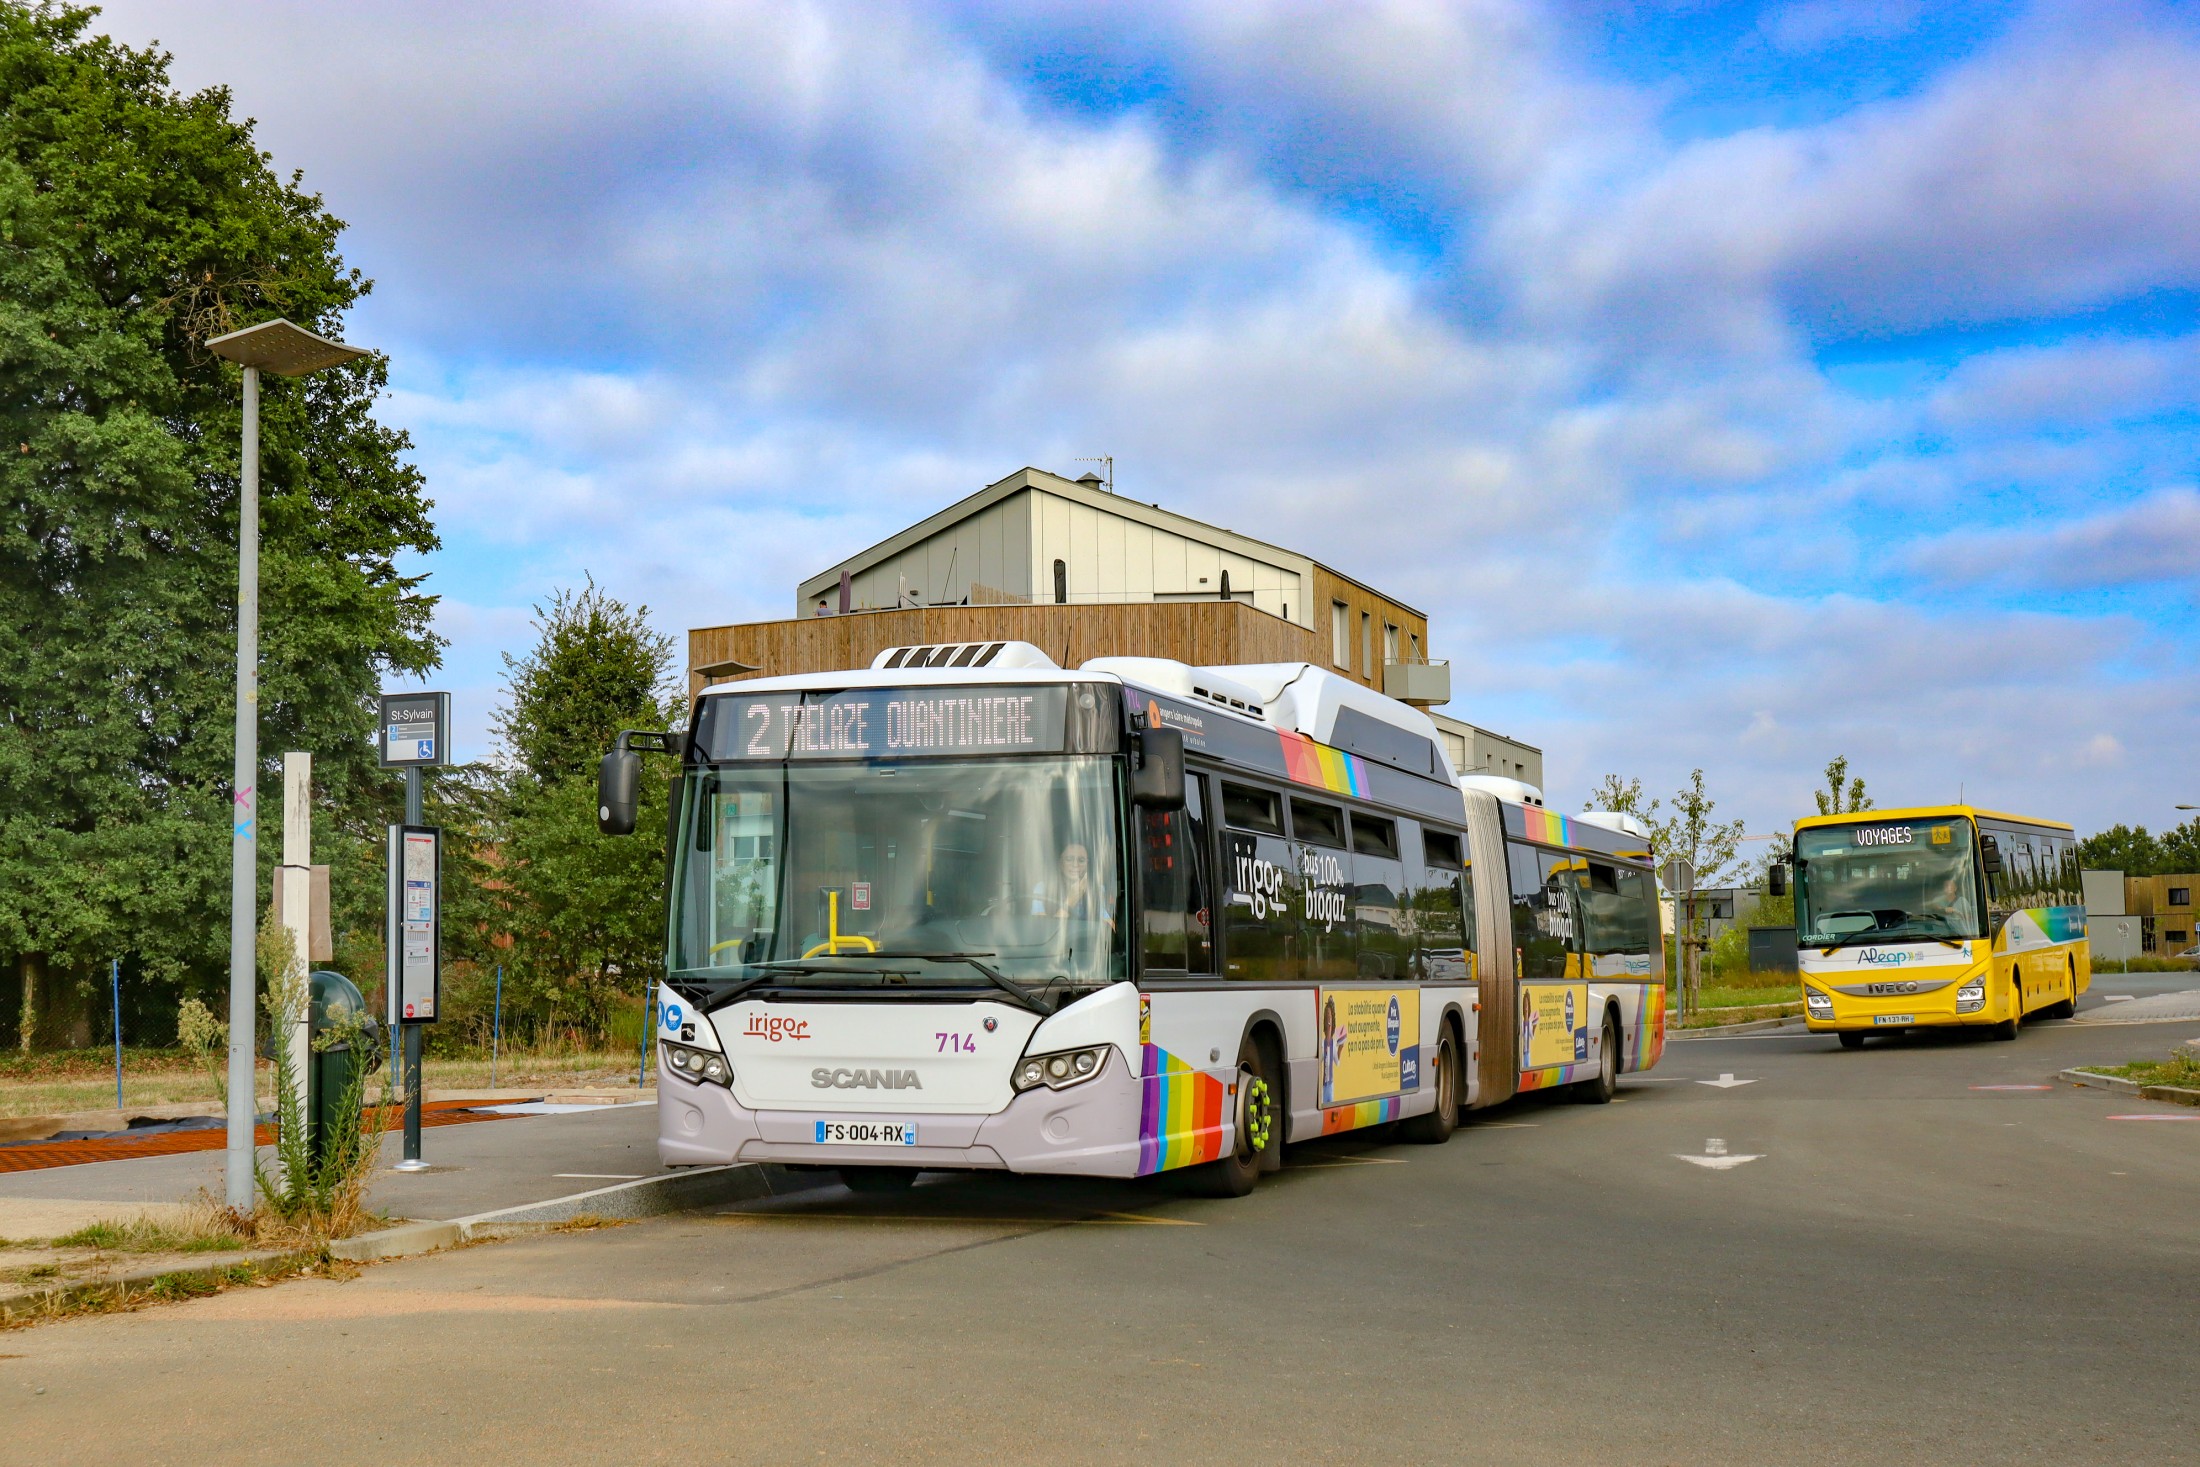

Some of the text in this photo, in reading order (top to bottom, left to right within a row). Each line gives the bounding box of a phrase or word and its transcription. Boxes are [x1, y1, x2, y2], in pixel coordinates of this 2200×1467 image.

[391, 708, 433, 722] St-Sylvain
[747, 696, 1033, 755] 2 TRELAZE QUANTINIERE
[1856, 826, 1912, 847] VOYAGES
[1303, 847, 1344, 888] bus 100%
[1234, 842, 1285, 920] irigo
[1305, 878, 1347, 933] biogaz
[1548, 908, 1573, 946] biogaz
[1802, 932, 1836, 942] CORDIER
[1857, 947, 1907, 967] Aléop
[1868, 981, 1918, 994] IVECO
[745, 1012, 808, 1042] irigo
[935, 1032, 976, 1053] 714
[810, 1067, 923, 1090] SCANIA
[825, 1124, 903, 1142] FS-004-RX
[905, 1134, 914, 1143] 49
